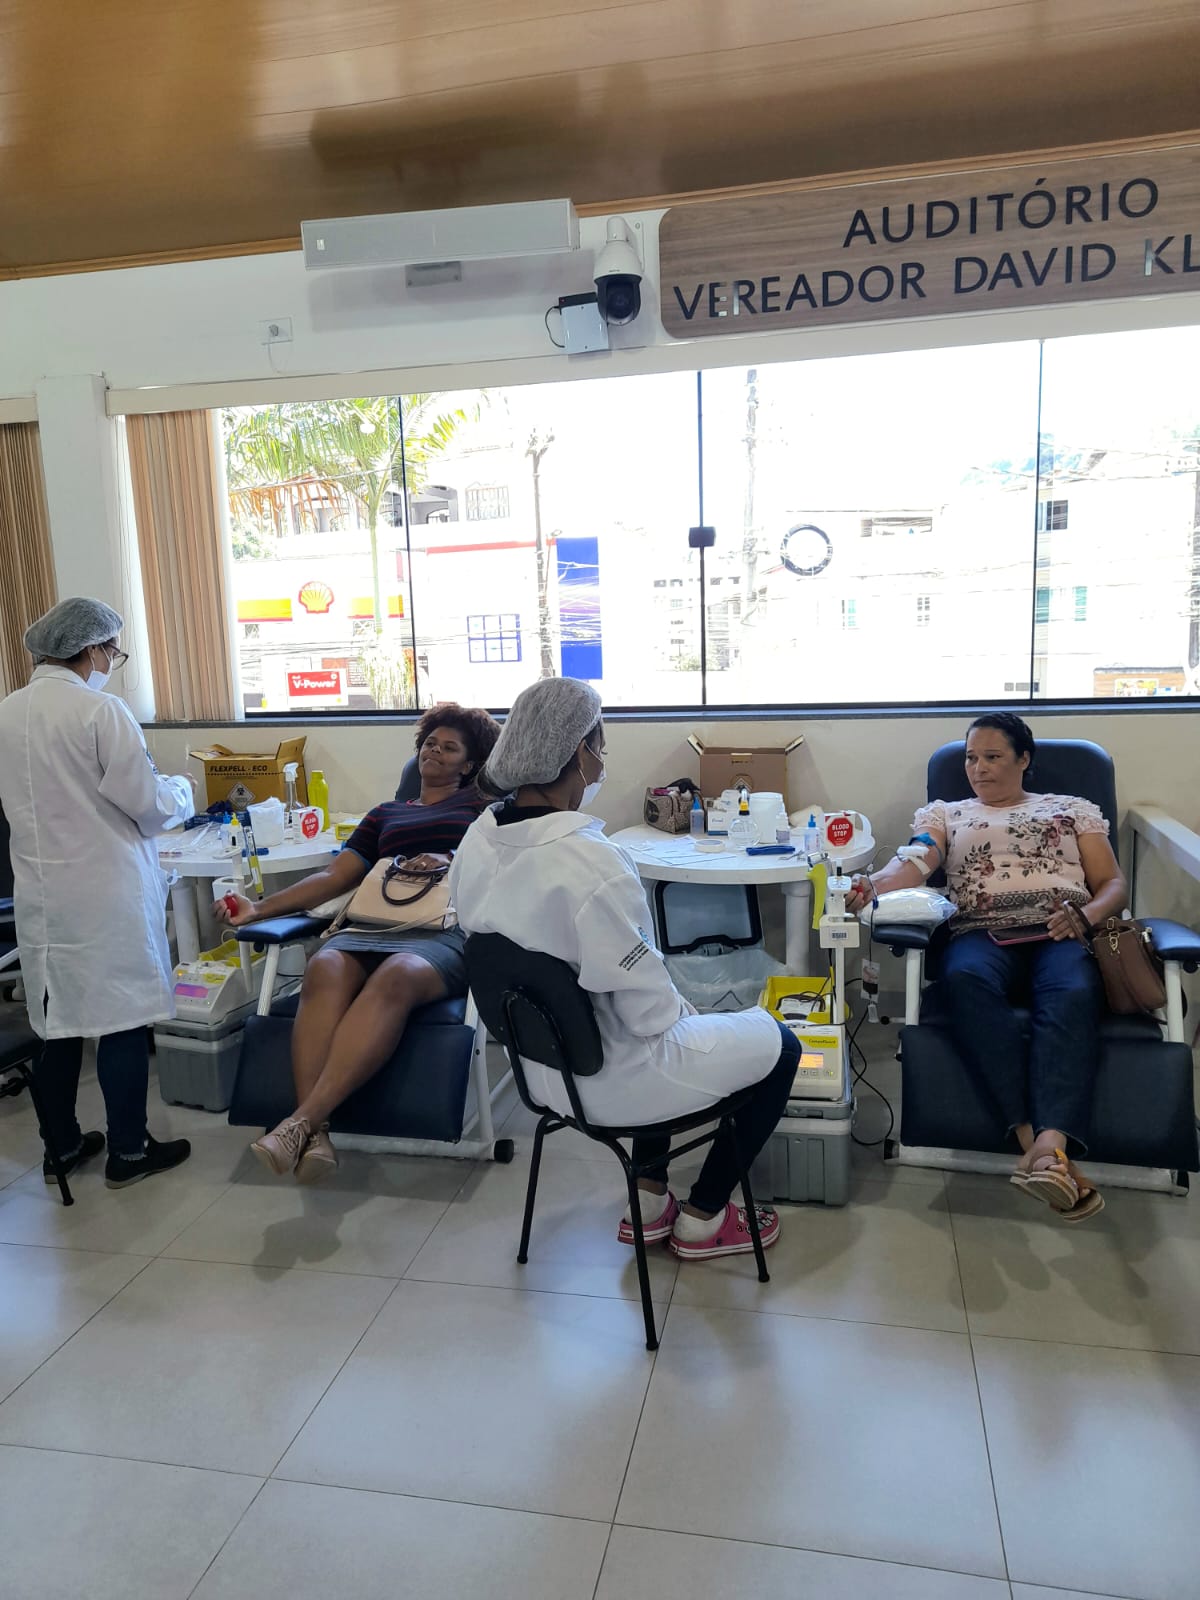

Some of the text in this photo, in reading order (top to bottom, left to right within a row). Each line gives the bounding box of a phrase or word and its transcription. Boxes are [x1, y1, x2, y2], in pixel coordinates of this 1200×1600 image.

[843, 178, 1159, 248] AUDITÓRIO
[673, 261, 926, 320] VEREADOR
[954, 242, 1116, 294] DAVID
